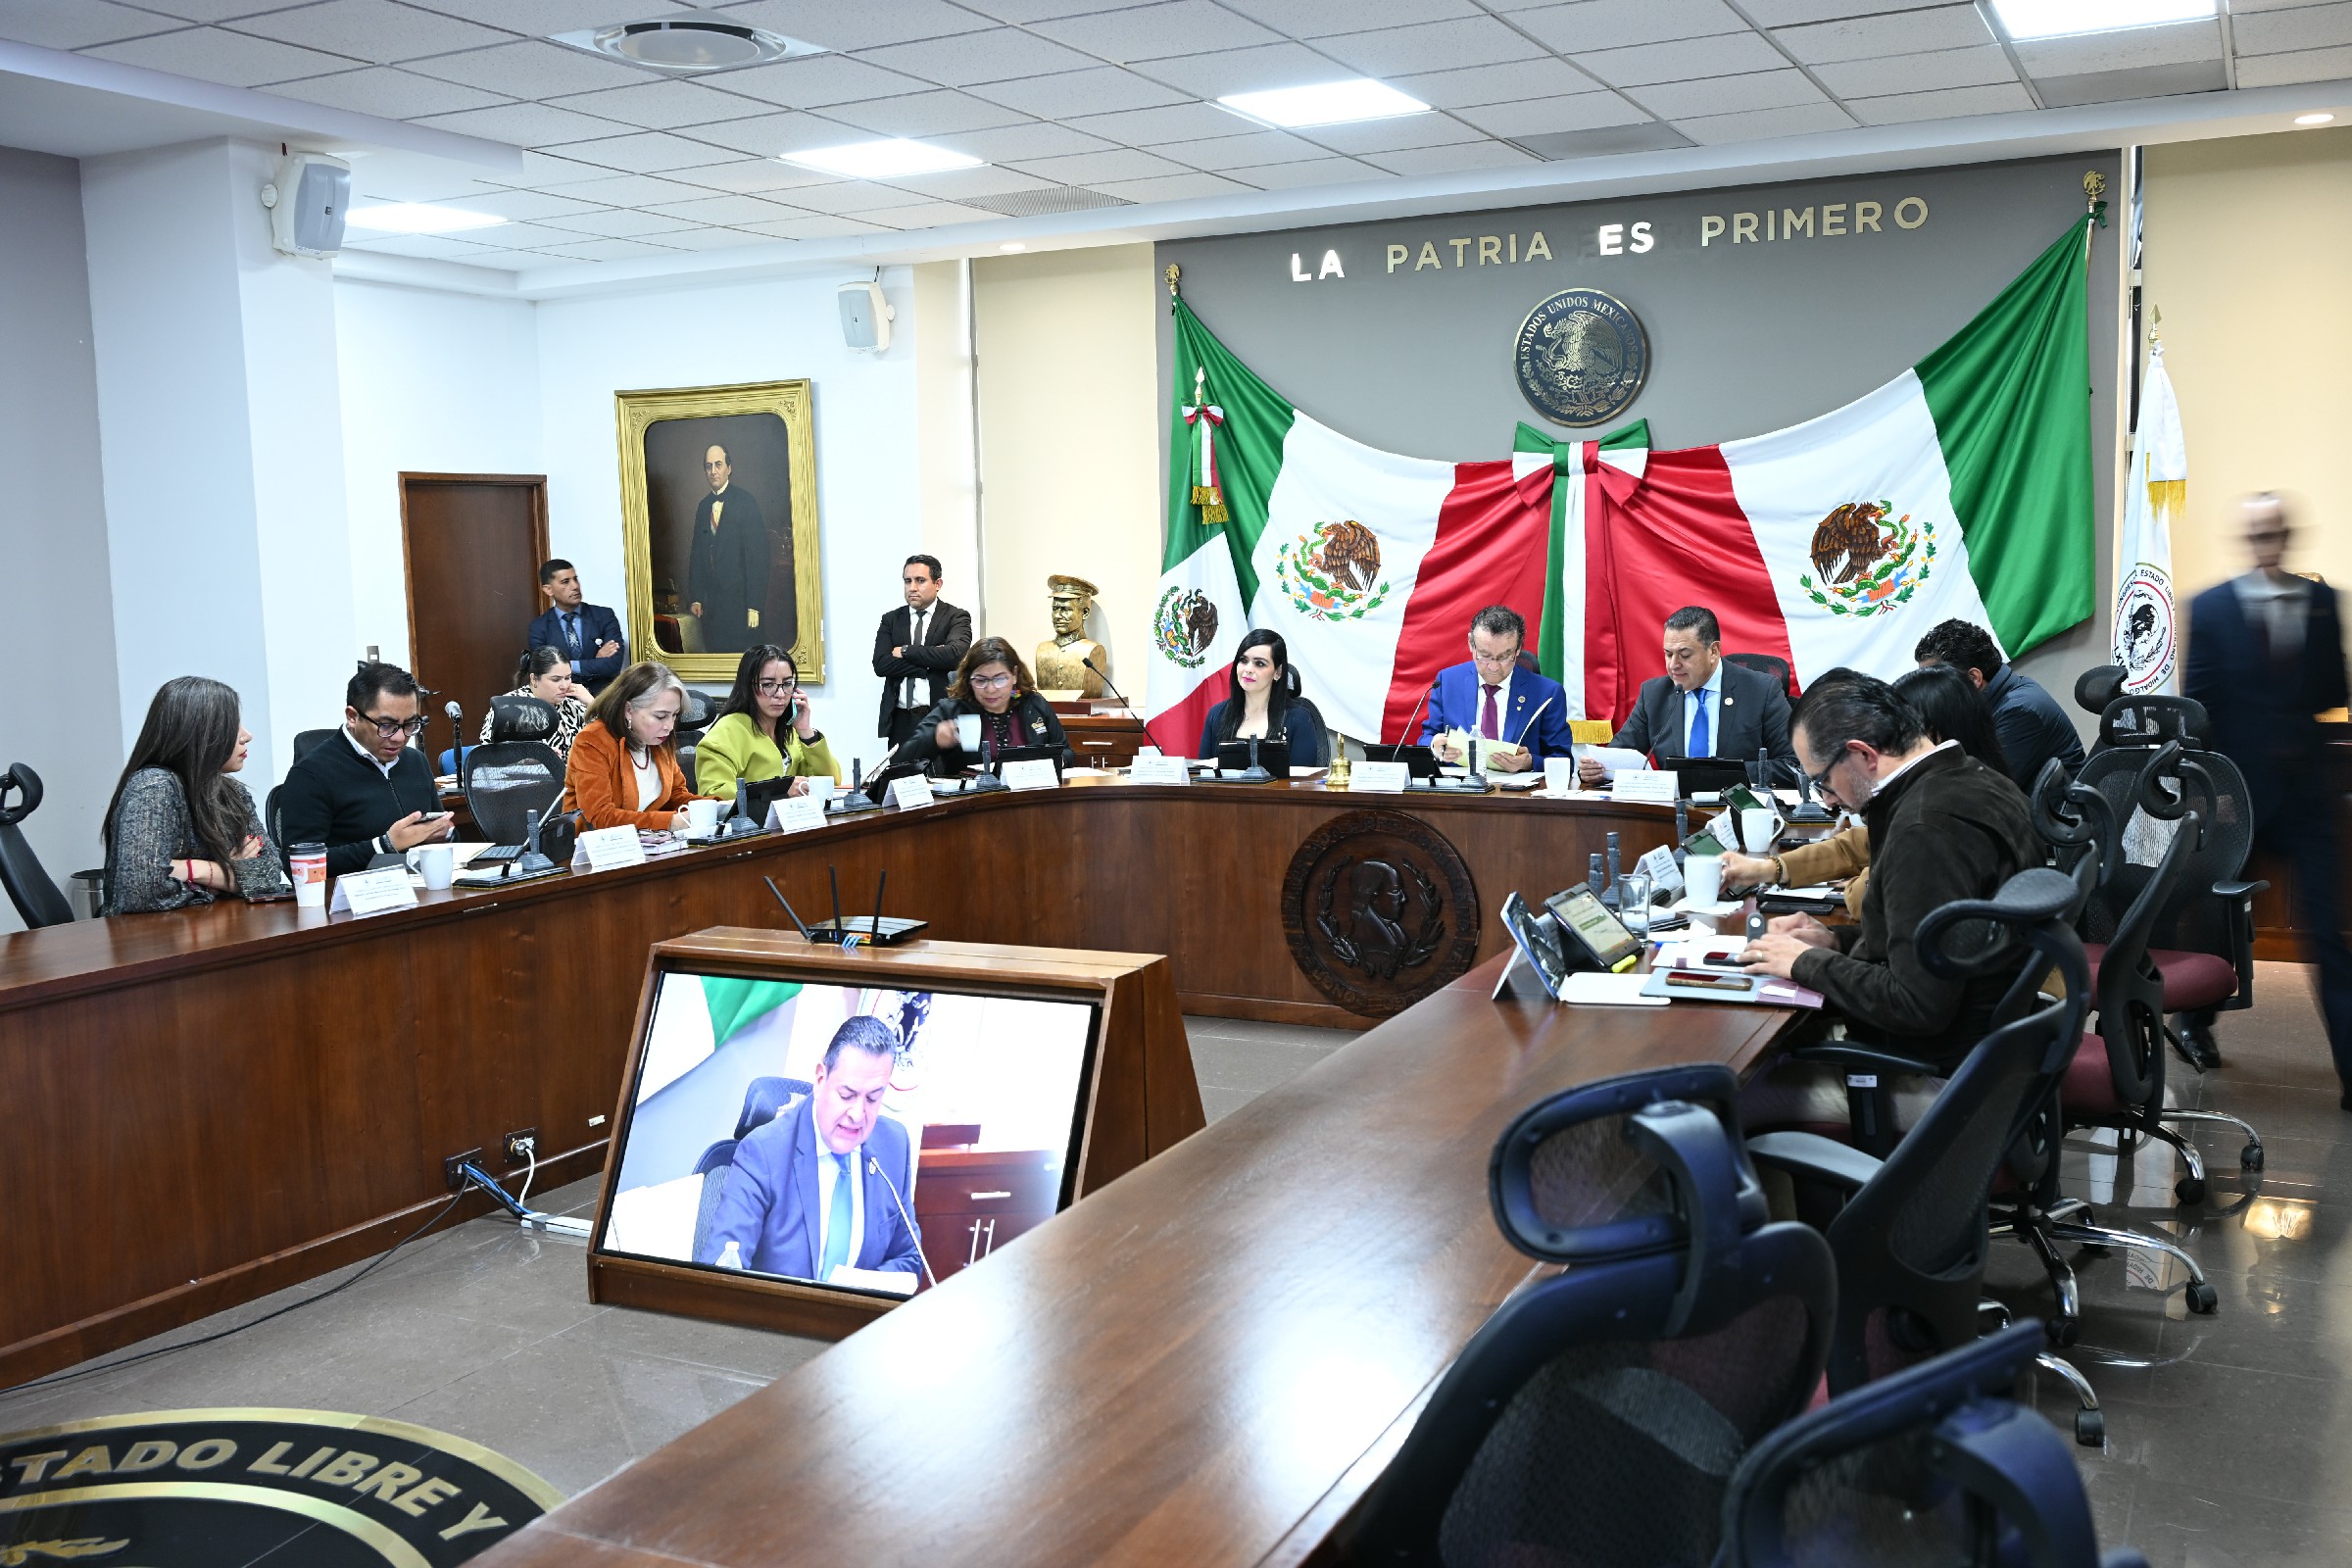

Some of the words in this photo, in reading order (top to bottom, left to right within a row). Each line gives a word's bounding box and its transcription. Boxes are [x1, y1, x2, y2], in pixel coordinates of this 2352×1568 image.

[1291, 249, 1346, 282] LA
[1386, 231, 1553, 274] PATRIA
[1598, 221, 1654, 256] ES
[1701, 196, 1929, 247] PRIMERO
[1521, 312, 1546, 360] ESTADOS
[1547, 297, 1589, 314] UNIDOS
[1592, 299, 1638, 351] MEXICANOS
[2140, 569, 2165, 586] ESTADO
[2129, 675, 2160, 695] HIDALGO
[2161, 663, 2170, 674] DE
[0, 1439, 238, 1486] TADO
[246, 1441, 463, 1517] LIBRE
[437, 1500, 509, 1542] Y
